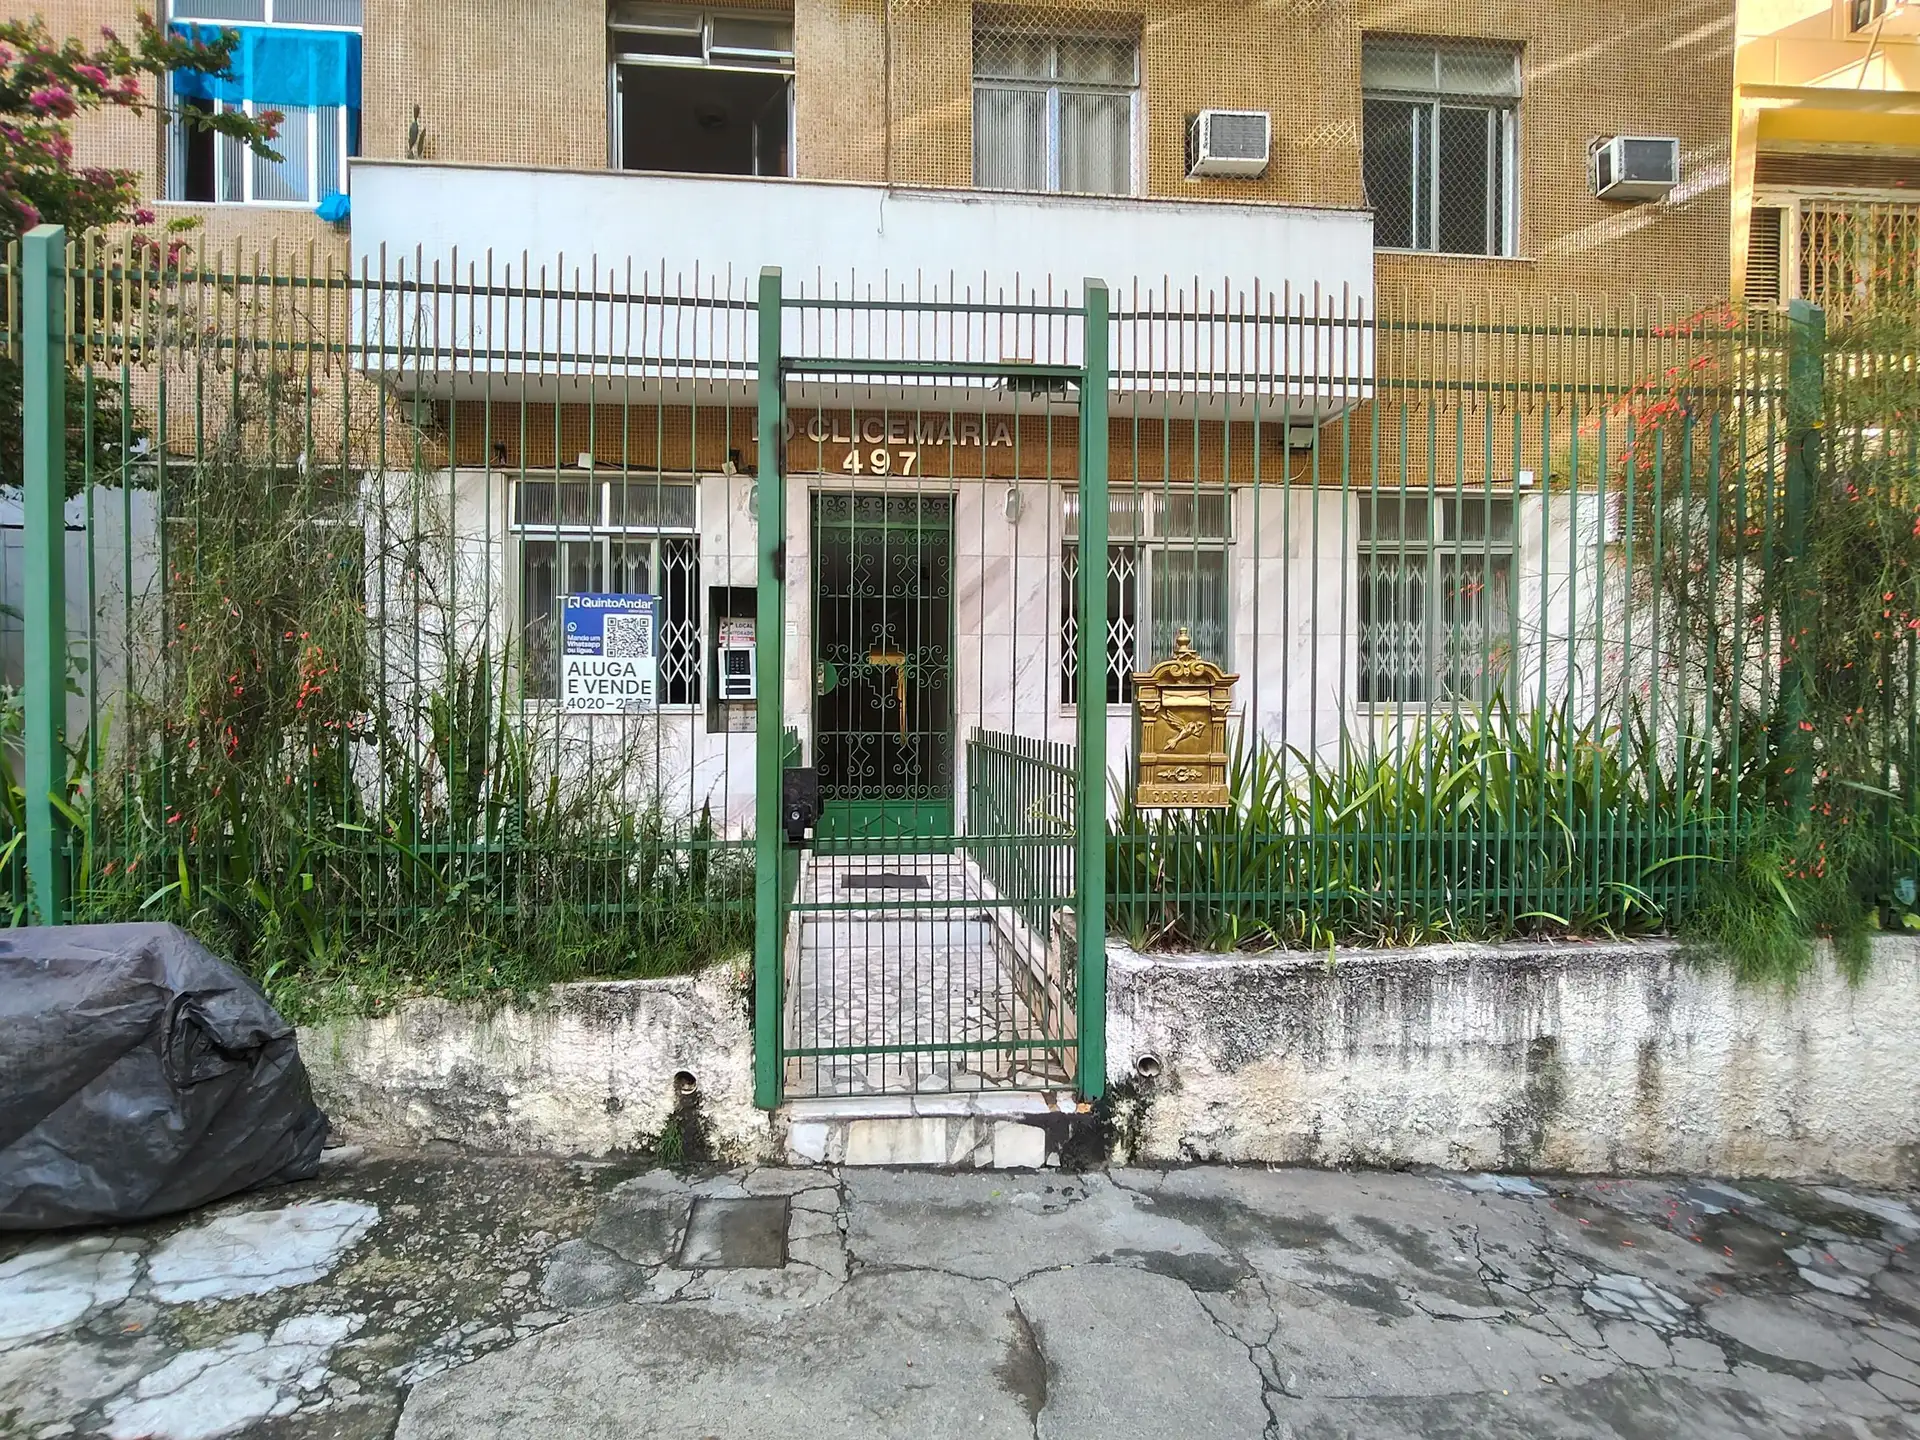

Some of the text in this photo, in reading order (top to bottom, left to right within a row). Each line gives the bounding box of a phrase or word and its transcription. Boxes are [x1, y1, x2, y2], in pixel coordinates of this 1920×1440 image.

[843, 448, 918, 476] 497
[581, 597, 653, 609] QuintoAndar
[567, 661, 637, 677] ALUGA
[568, 679, 652, 695] E VENDE
[1152, 790, 1215, 804] CORREIO
